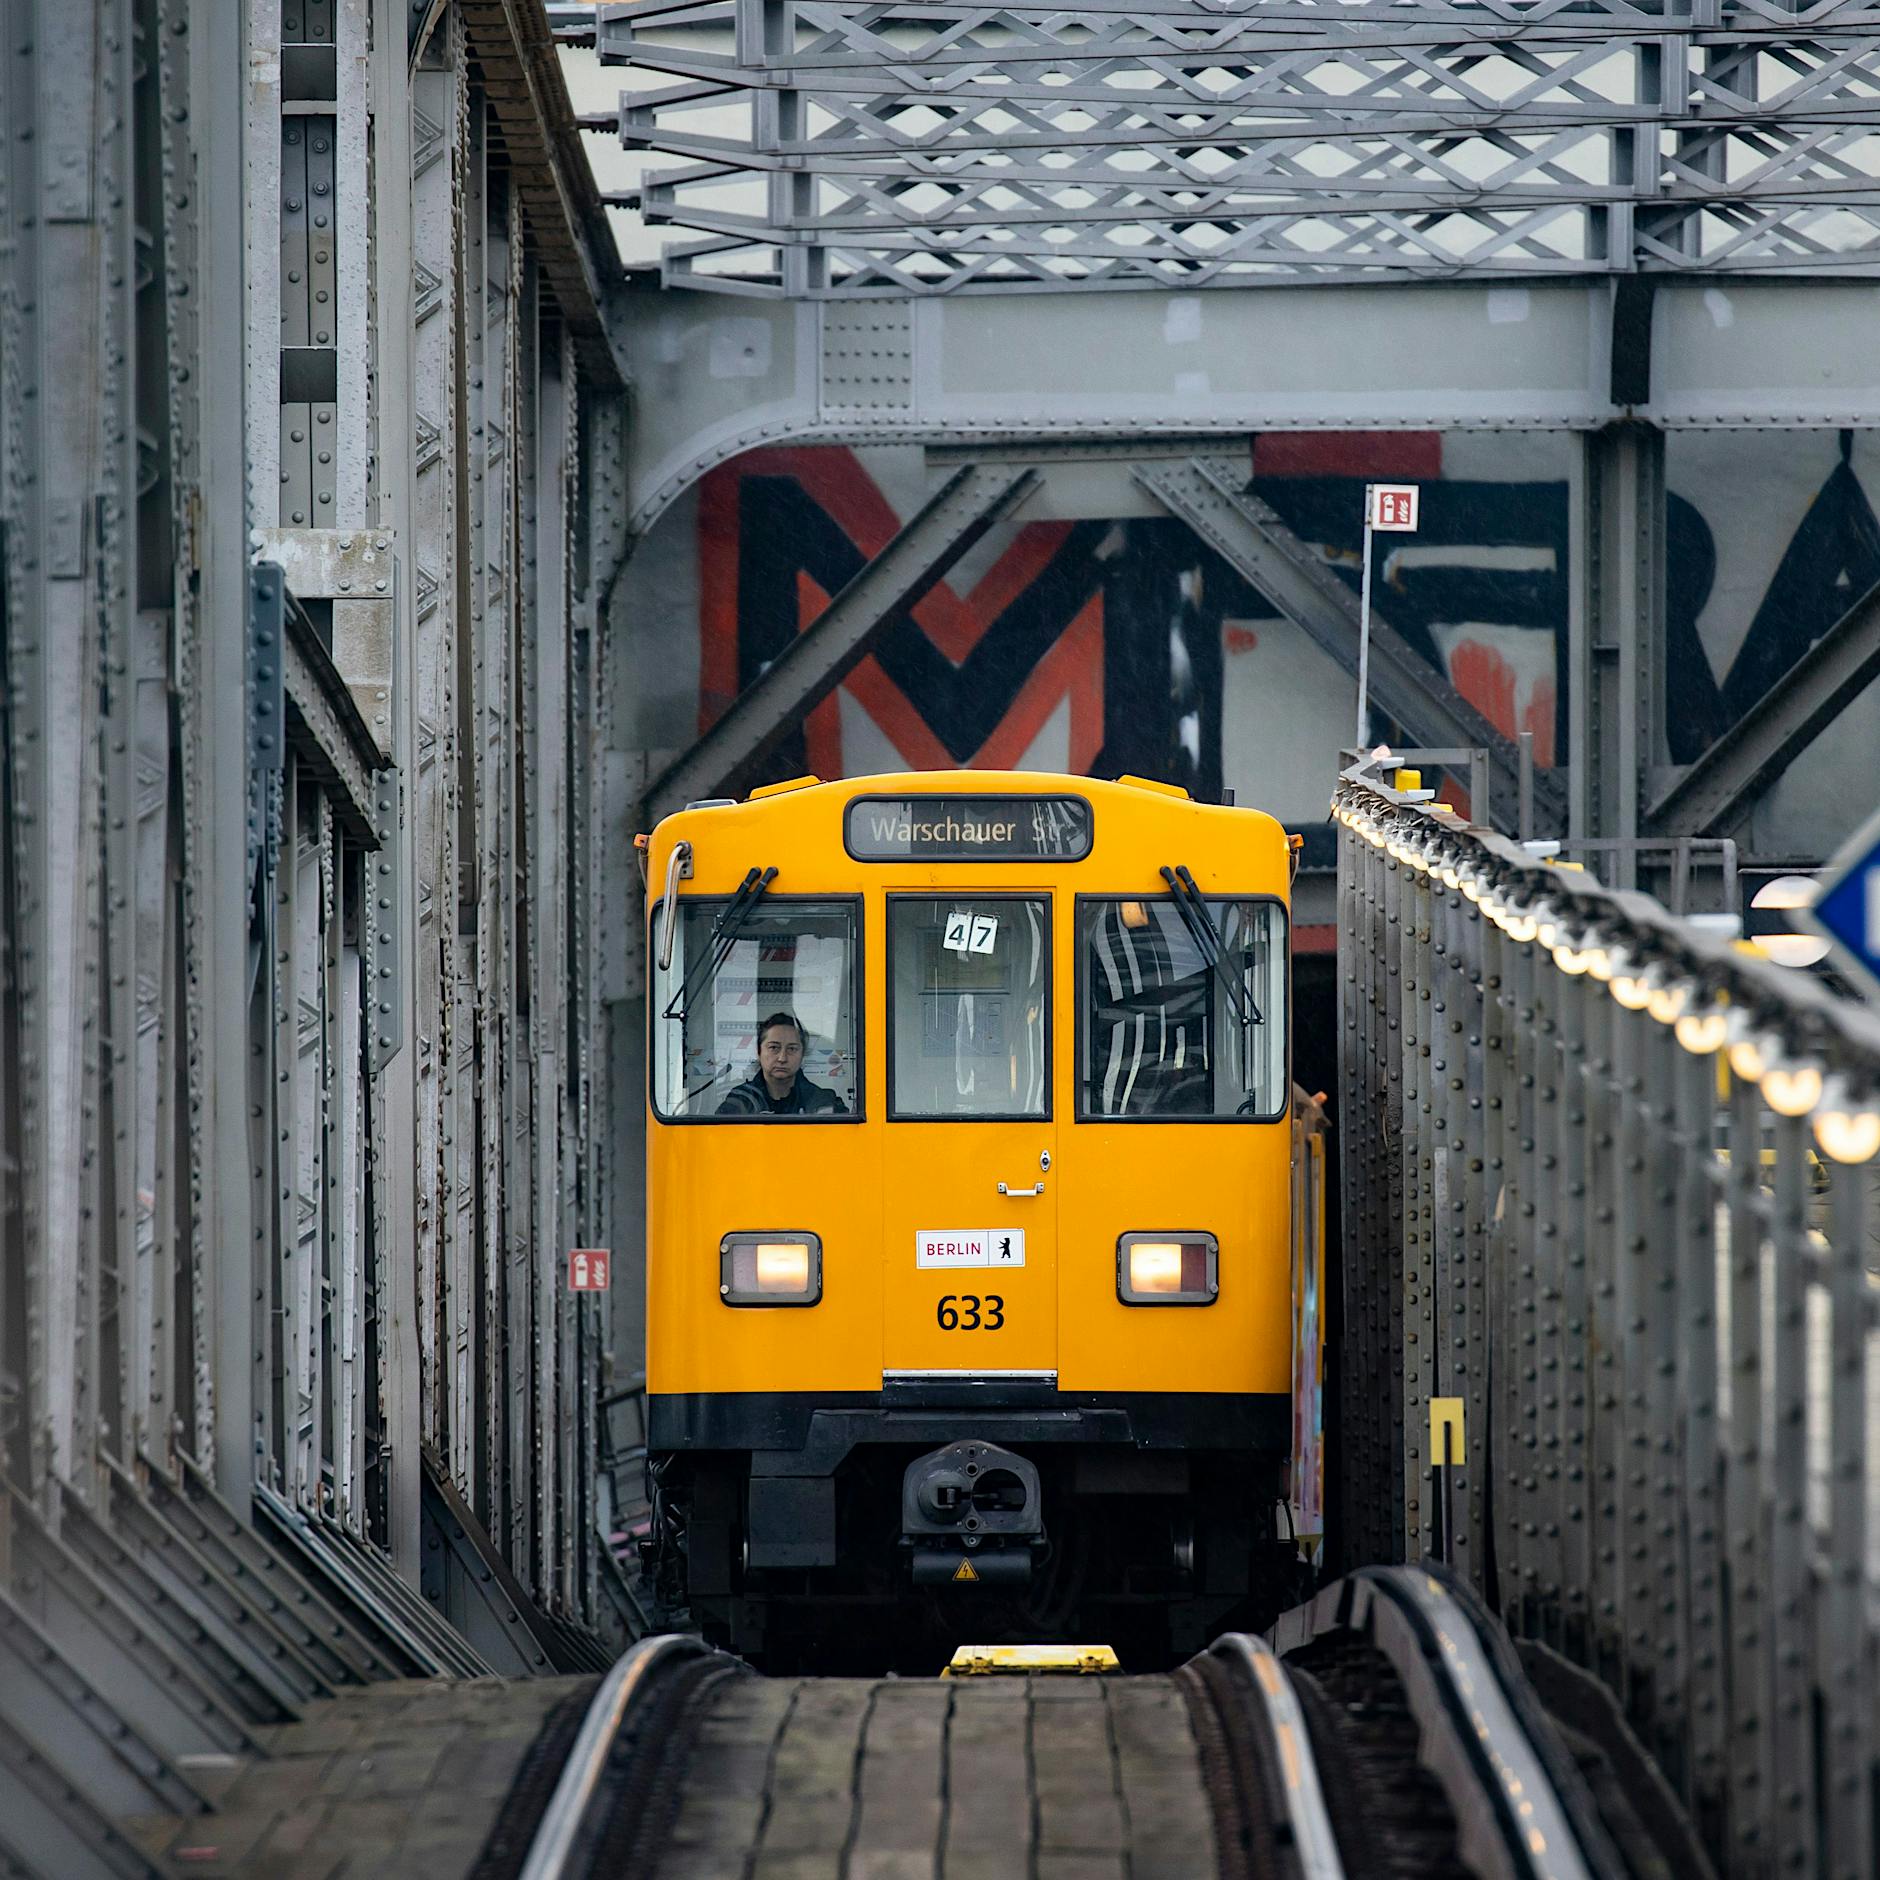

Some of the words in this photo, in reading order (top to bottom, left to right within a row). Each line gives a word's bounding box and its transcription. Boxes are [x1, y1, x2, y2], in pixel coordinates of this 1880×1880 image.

[870, 815, 1016, 842] Warschauer
[926, 1242, 981, 1256] BERLIN
[936, 1294, 1005, 1331] 633
